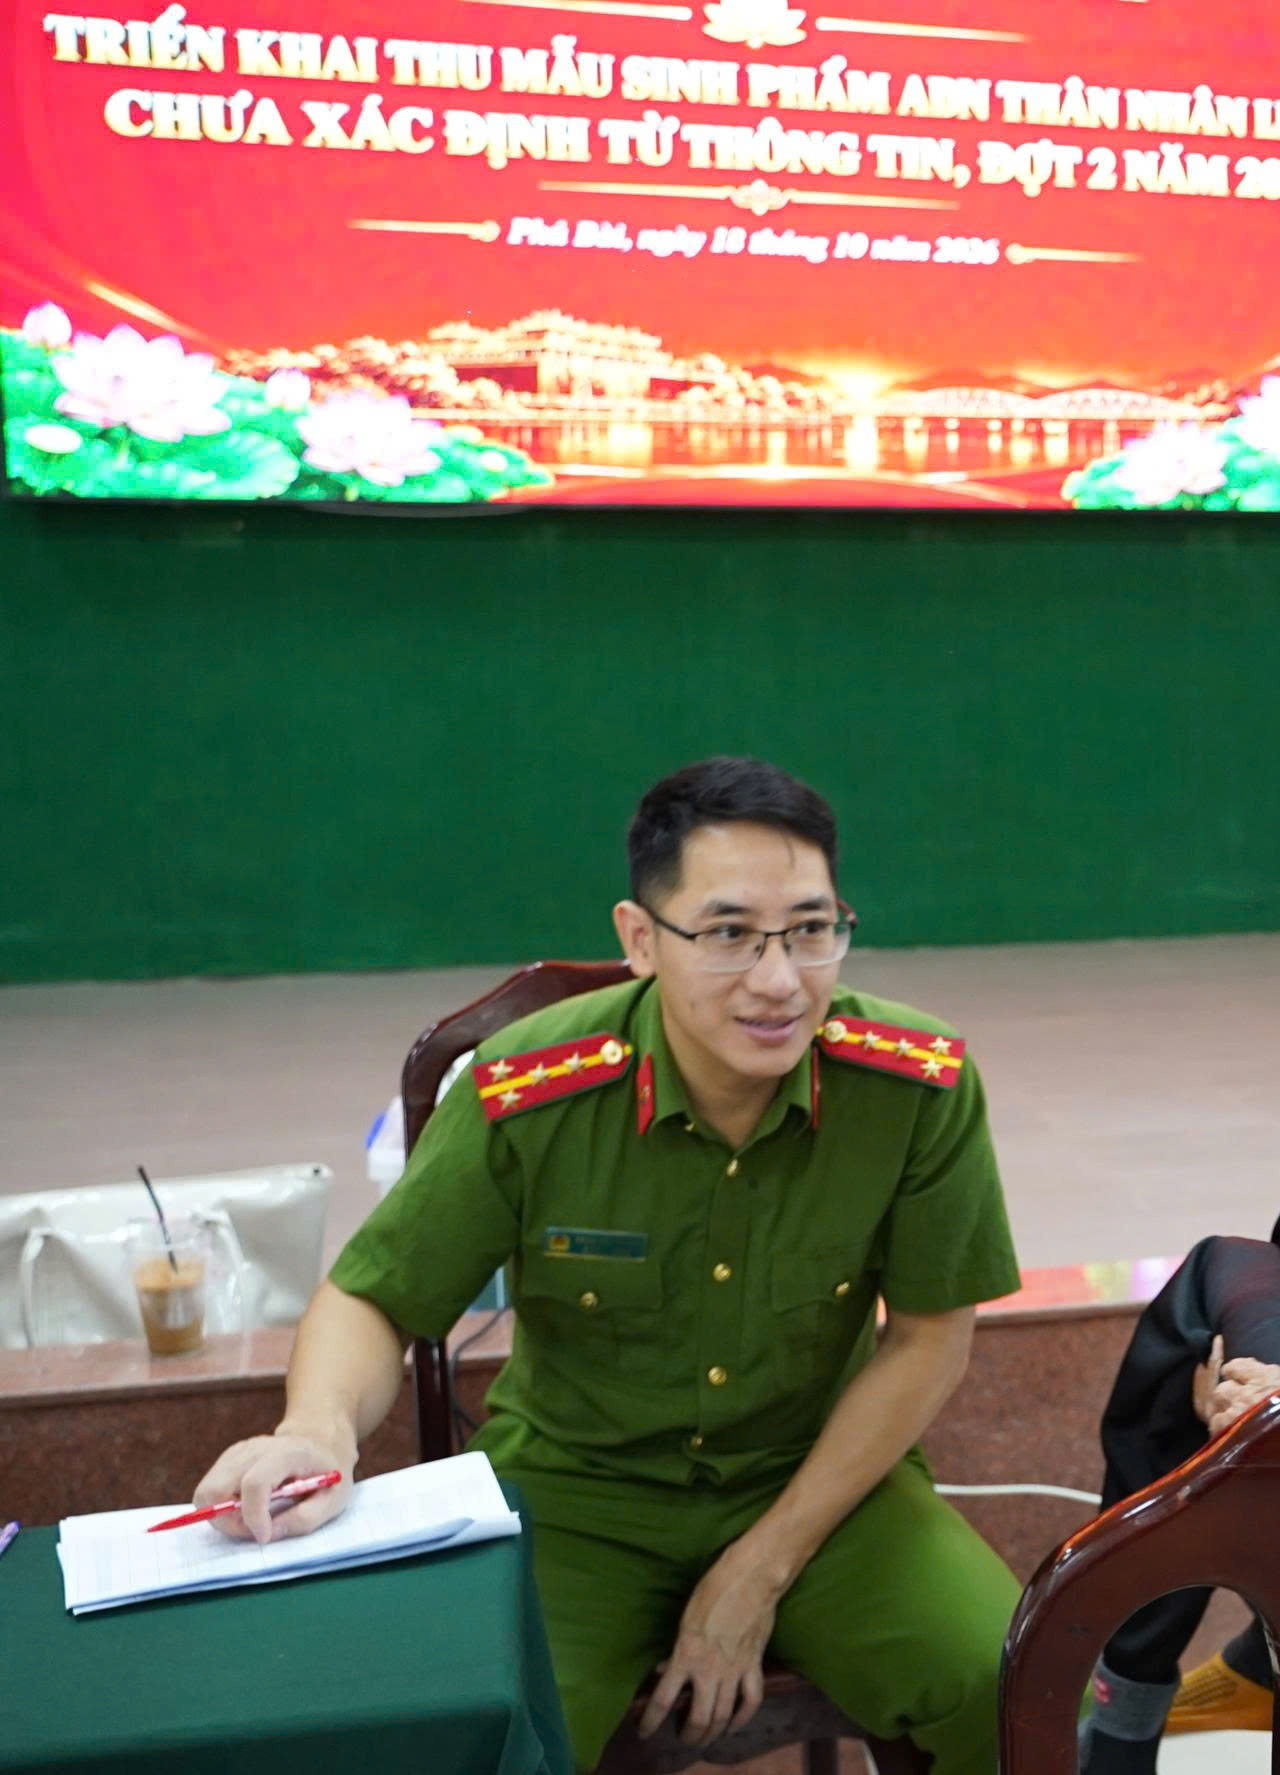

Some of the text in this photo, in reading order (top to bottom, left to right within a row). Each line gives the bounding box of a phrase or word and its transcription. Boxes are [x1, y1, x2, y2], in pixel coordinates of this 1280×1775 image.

[44, 4, 225, 72] TRIỂN
[235, 29, 378, 82] KHAI
[384, 39, 493, 90] THU
[500, 34, 615, 98] MẪU
[621, 55, 739, 105] SINH
[746, 55, 891, 114] PHẨM
[896, 74, 991, 121] ADN
[995, 76, 1120, 129] THÂN
[1125, 85, 1249, 138] NHÂN
[105, 89, 293, 145] CHƯA
[301, 94, 434, 153] XÁC
[443, 110, 590, 169] ĐỊNH
[598, 110, 680, 166] TỪ
[681, 117, 862, 176] THÔNG
[867, 134, 971, 188] TIN,
[977, 139, 1083, 197] ĐỢT
[1087, 147, 1117, 190] 2
[1123, 142, 1230, 196] NĂM
